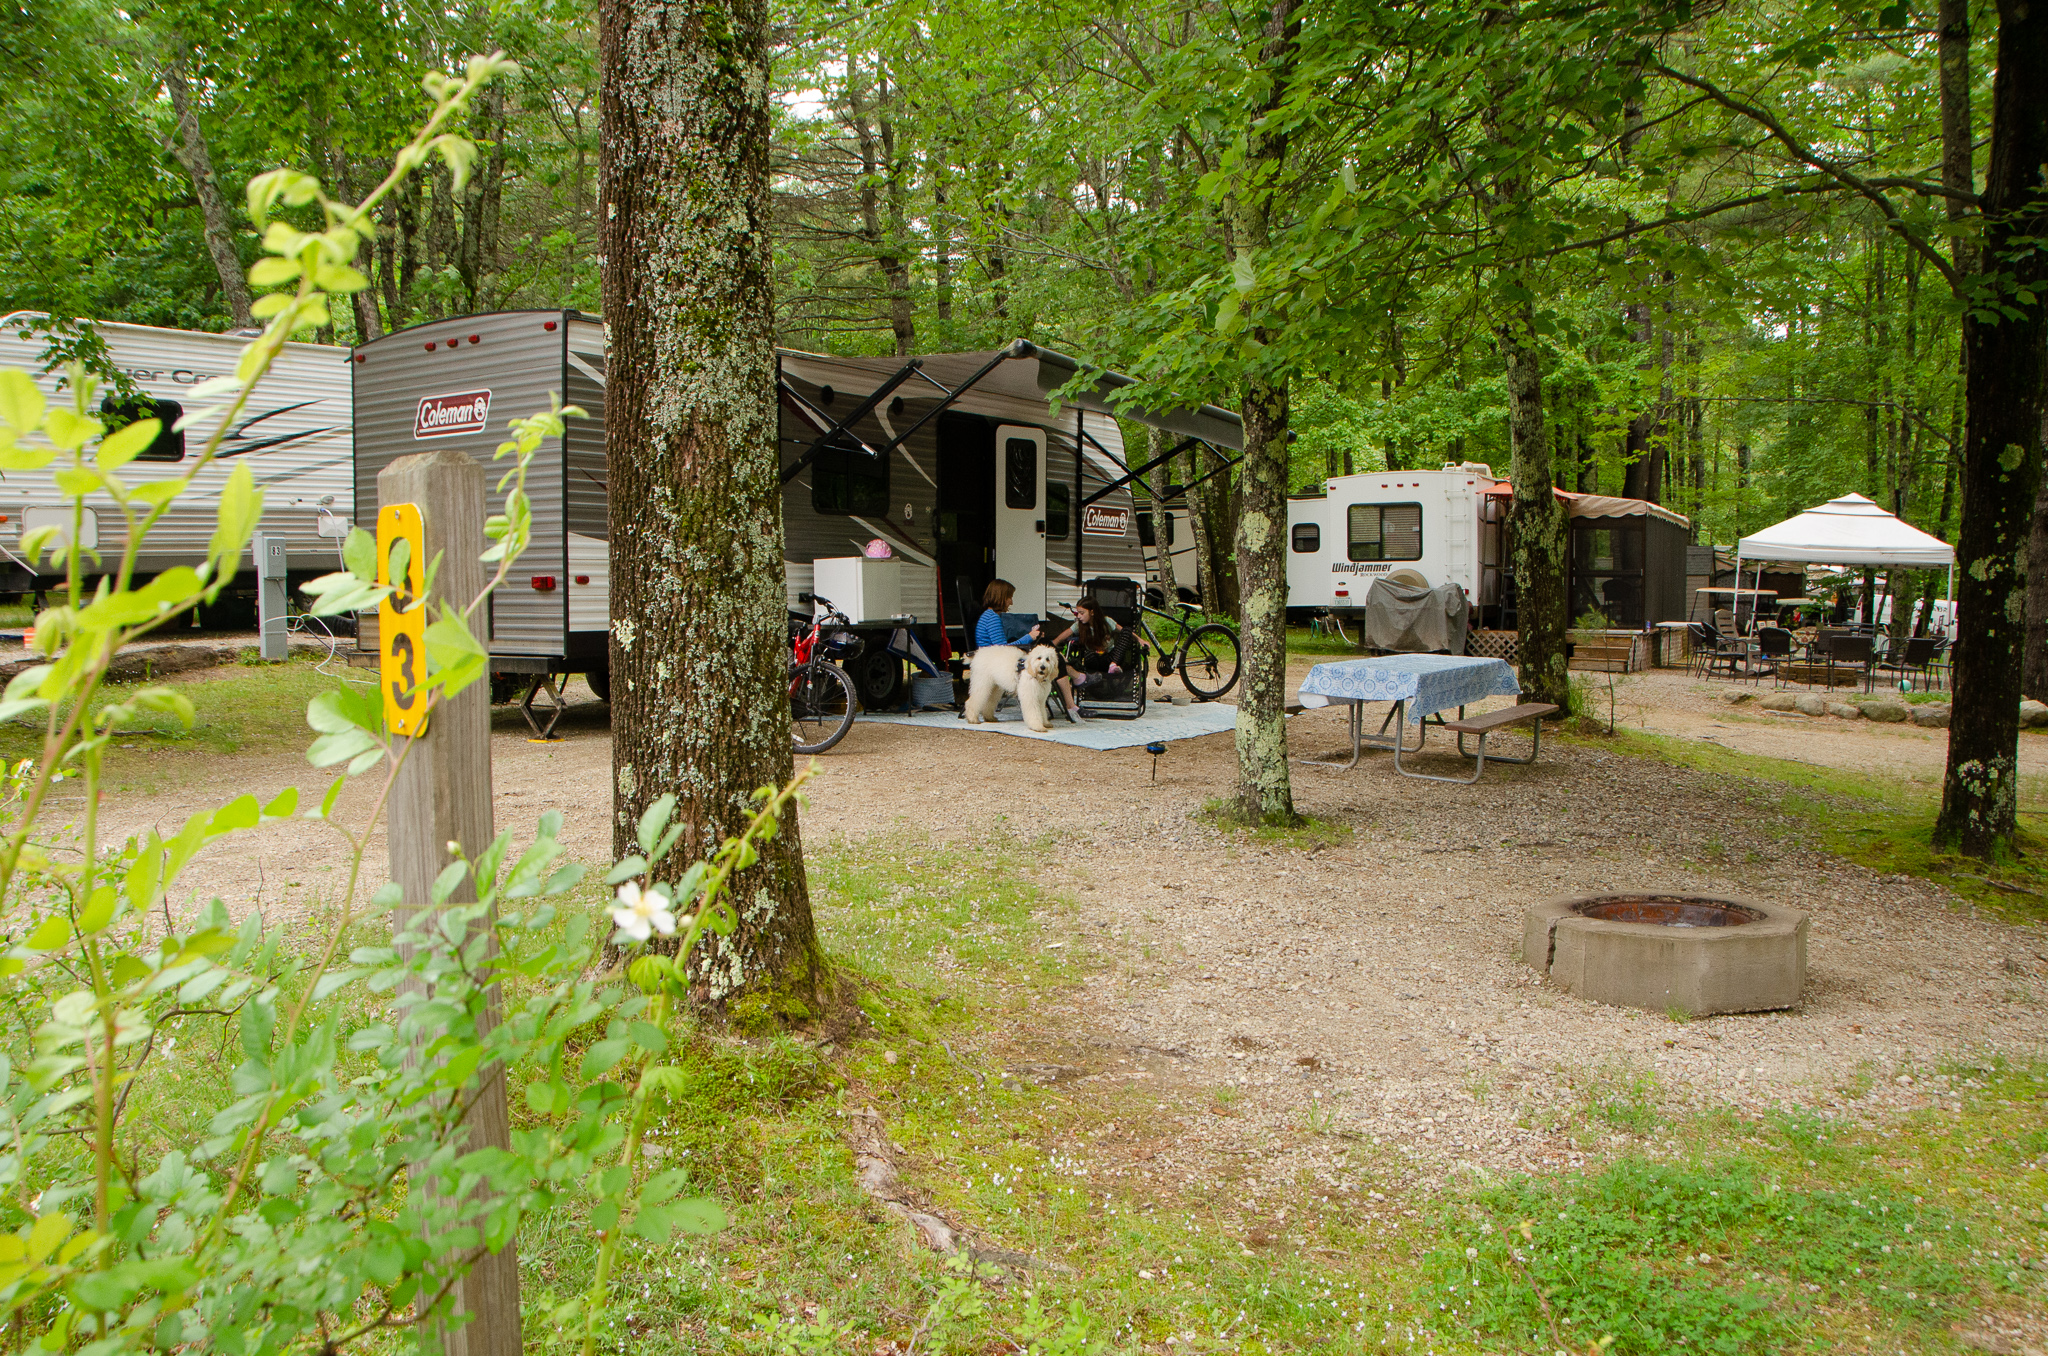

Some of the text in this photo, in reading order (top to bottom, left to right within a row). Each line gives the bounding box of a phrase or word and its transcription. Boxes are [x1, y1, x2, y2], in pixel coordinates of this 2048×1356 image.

[421, 401, 473, 428] Coleman
[1087, 508, 1119, 528] Coleman
[1331, 562, 1392, 576] Windjammer
